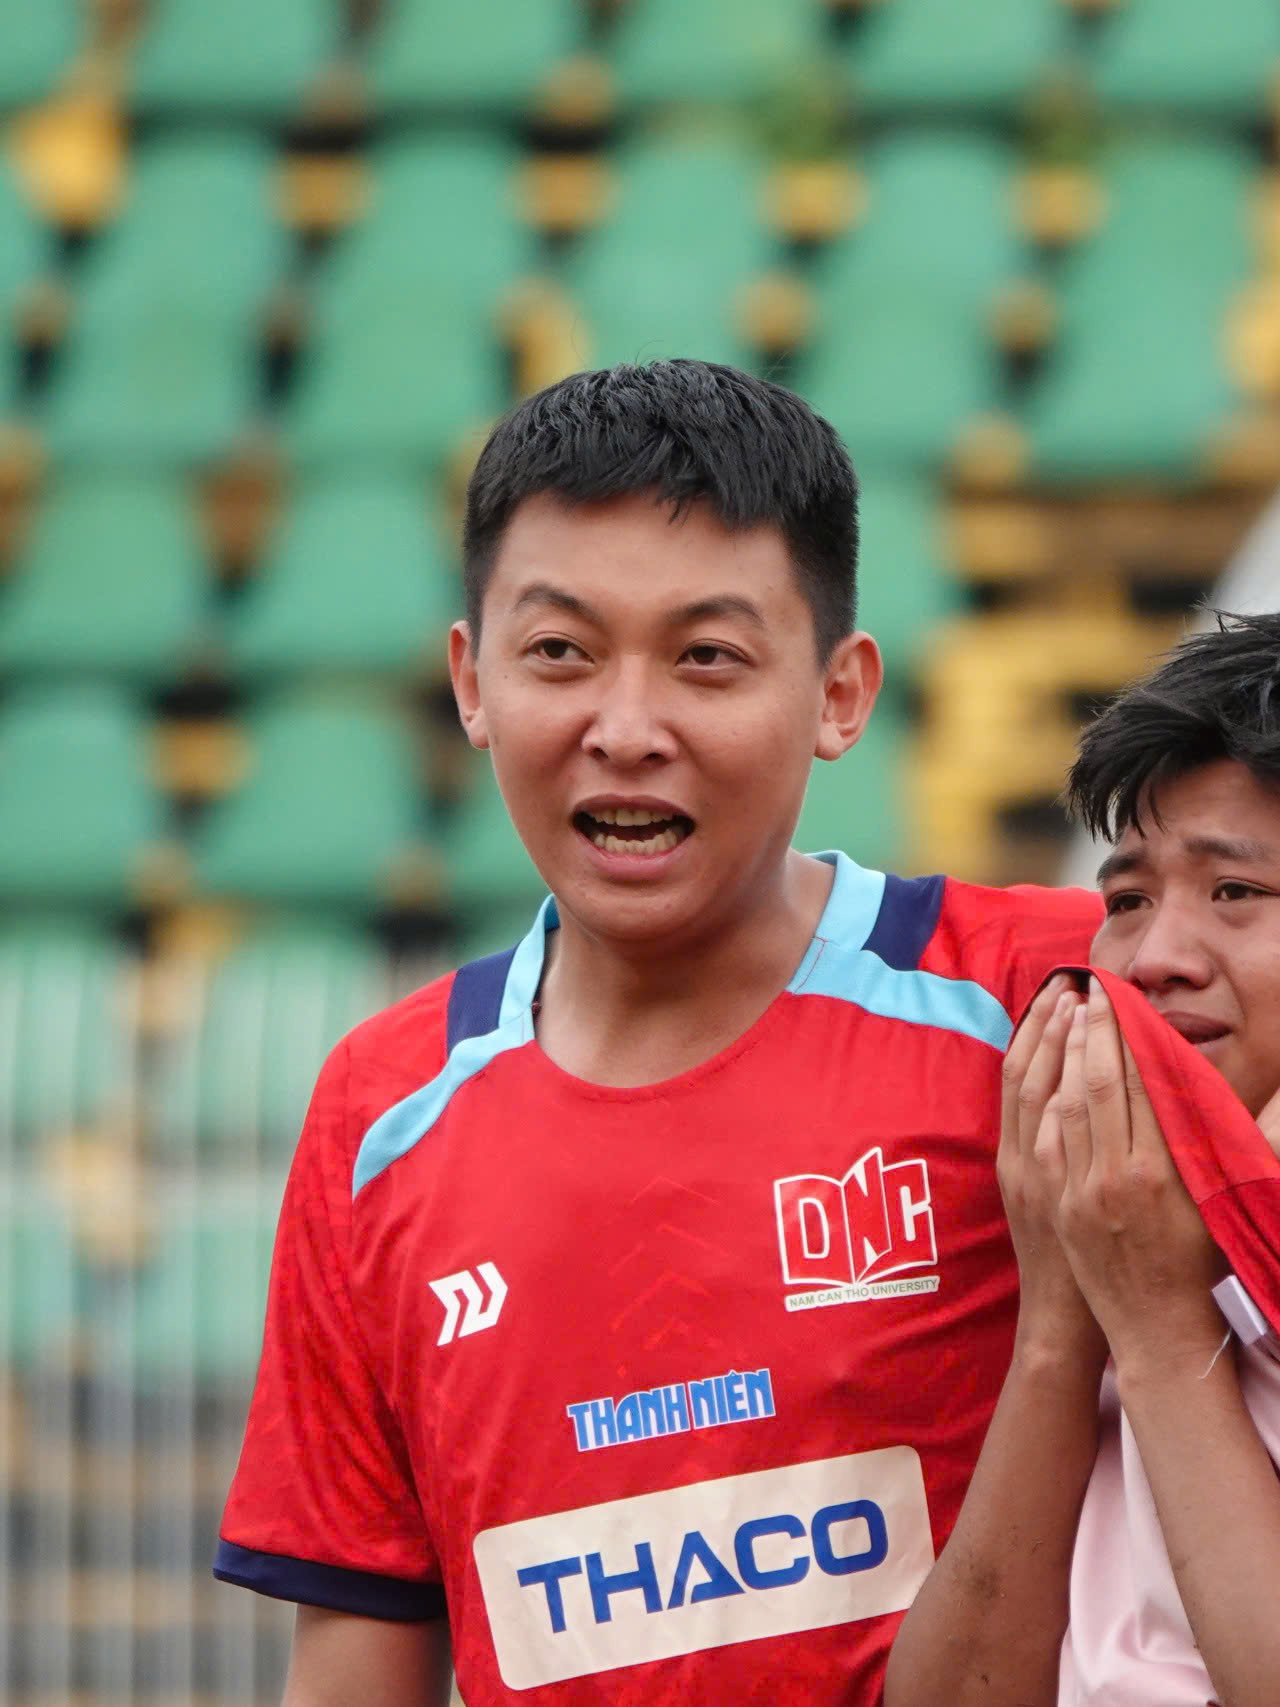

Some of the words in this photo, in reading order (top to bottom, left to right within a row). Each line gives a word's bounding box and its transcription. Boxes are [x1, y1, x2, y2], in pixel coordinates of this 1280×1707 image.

[774, 1146, 938, 1286] DNC
[789, 1294, 815, 1308] NAM
[818, 1290, 842, 1303] CAN
[845, 1287, 869, 1300] THO
[872, 1279, 938, 1297] UNIVERSITY
[566, 1383, 691, 1452] THANH
[688, 1368, 776, 1429] NIÊN
[517, 1499, 889, 1634] THACO
